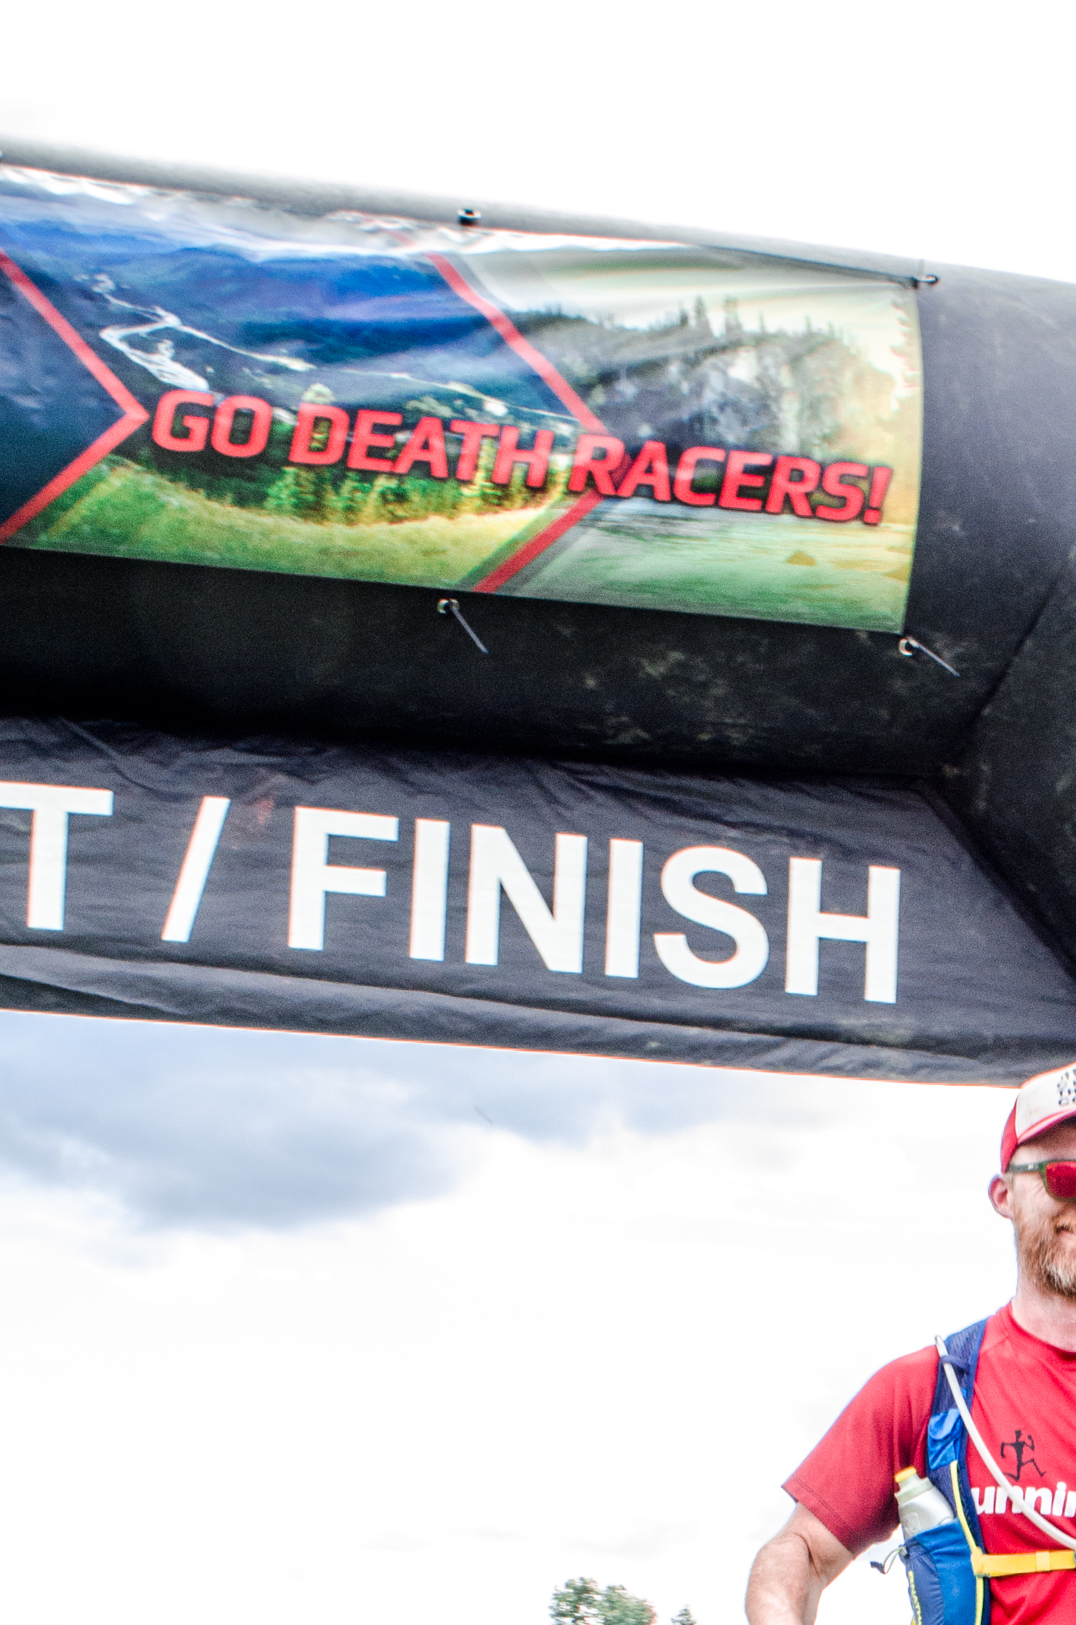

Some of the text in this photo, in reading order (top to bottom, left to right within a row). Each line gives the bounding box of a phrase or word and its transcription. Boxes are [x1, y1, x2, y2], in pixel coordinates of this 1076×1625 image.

[151, 389, 894, 526] GO DEATH RACERS!
[288, 806, 901, 1004] FINISH
